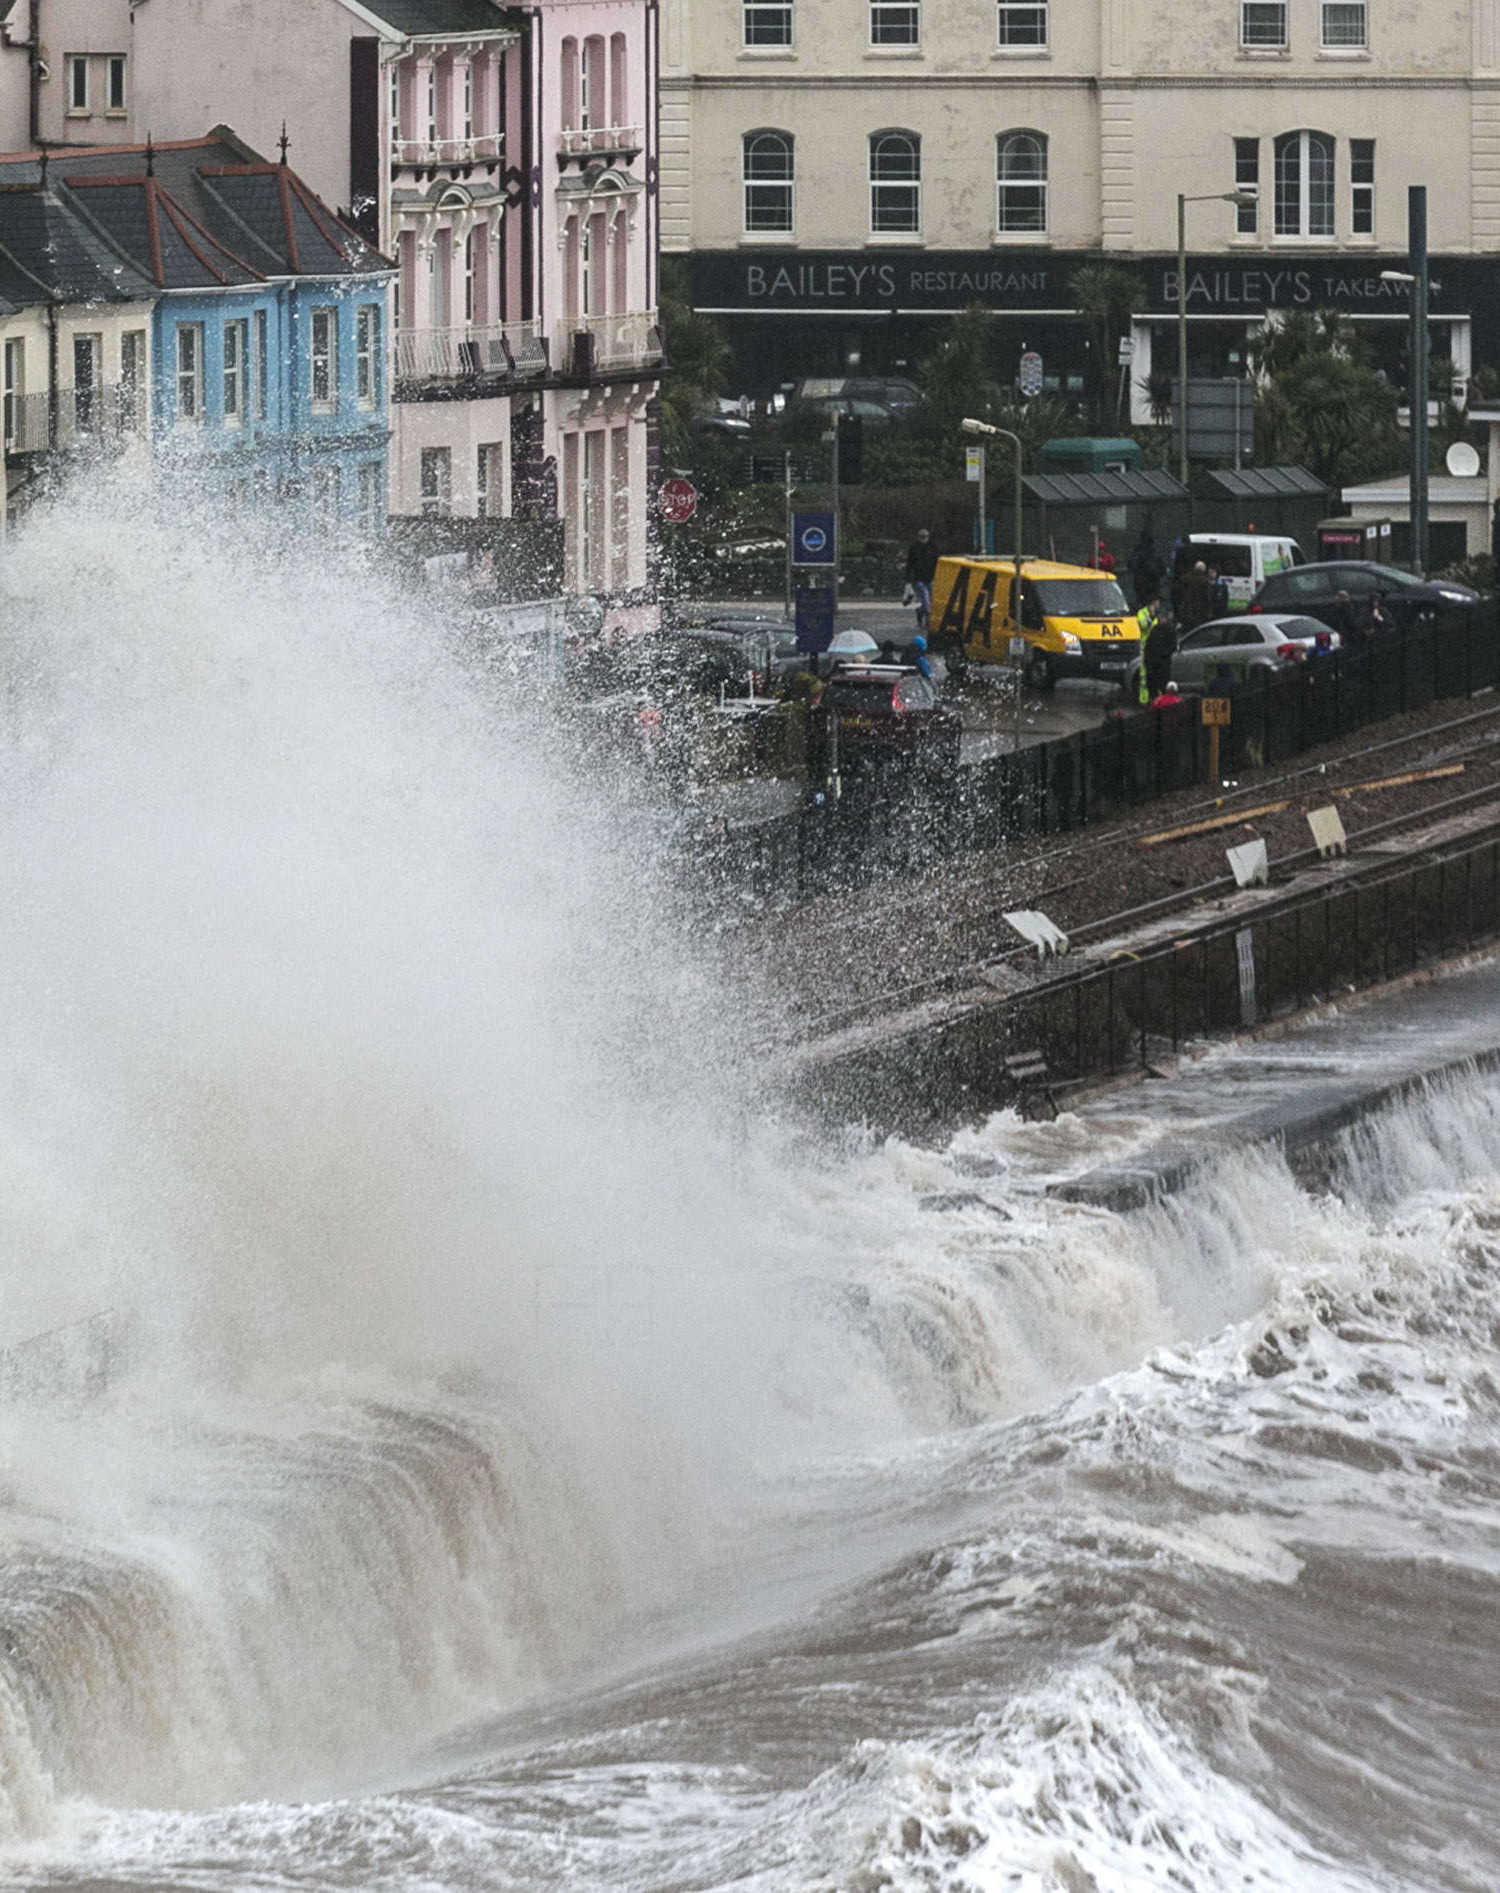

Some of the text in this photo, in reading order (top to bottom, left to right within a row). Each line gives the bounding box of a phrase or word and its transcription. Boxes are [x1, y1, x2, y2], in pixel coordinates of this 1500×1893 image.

[747, 265, 1048, 297] BAILEY'S RESTAURANT
[1163, 271, 1442, 302] BAILEY'S TAKEAWY
[660, 494, 694, 506] STOP
[938, 566, 997, 649] AA
[1101, 623, 1123, 637] AA
